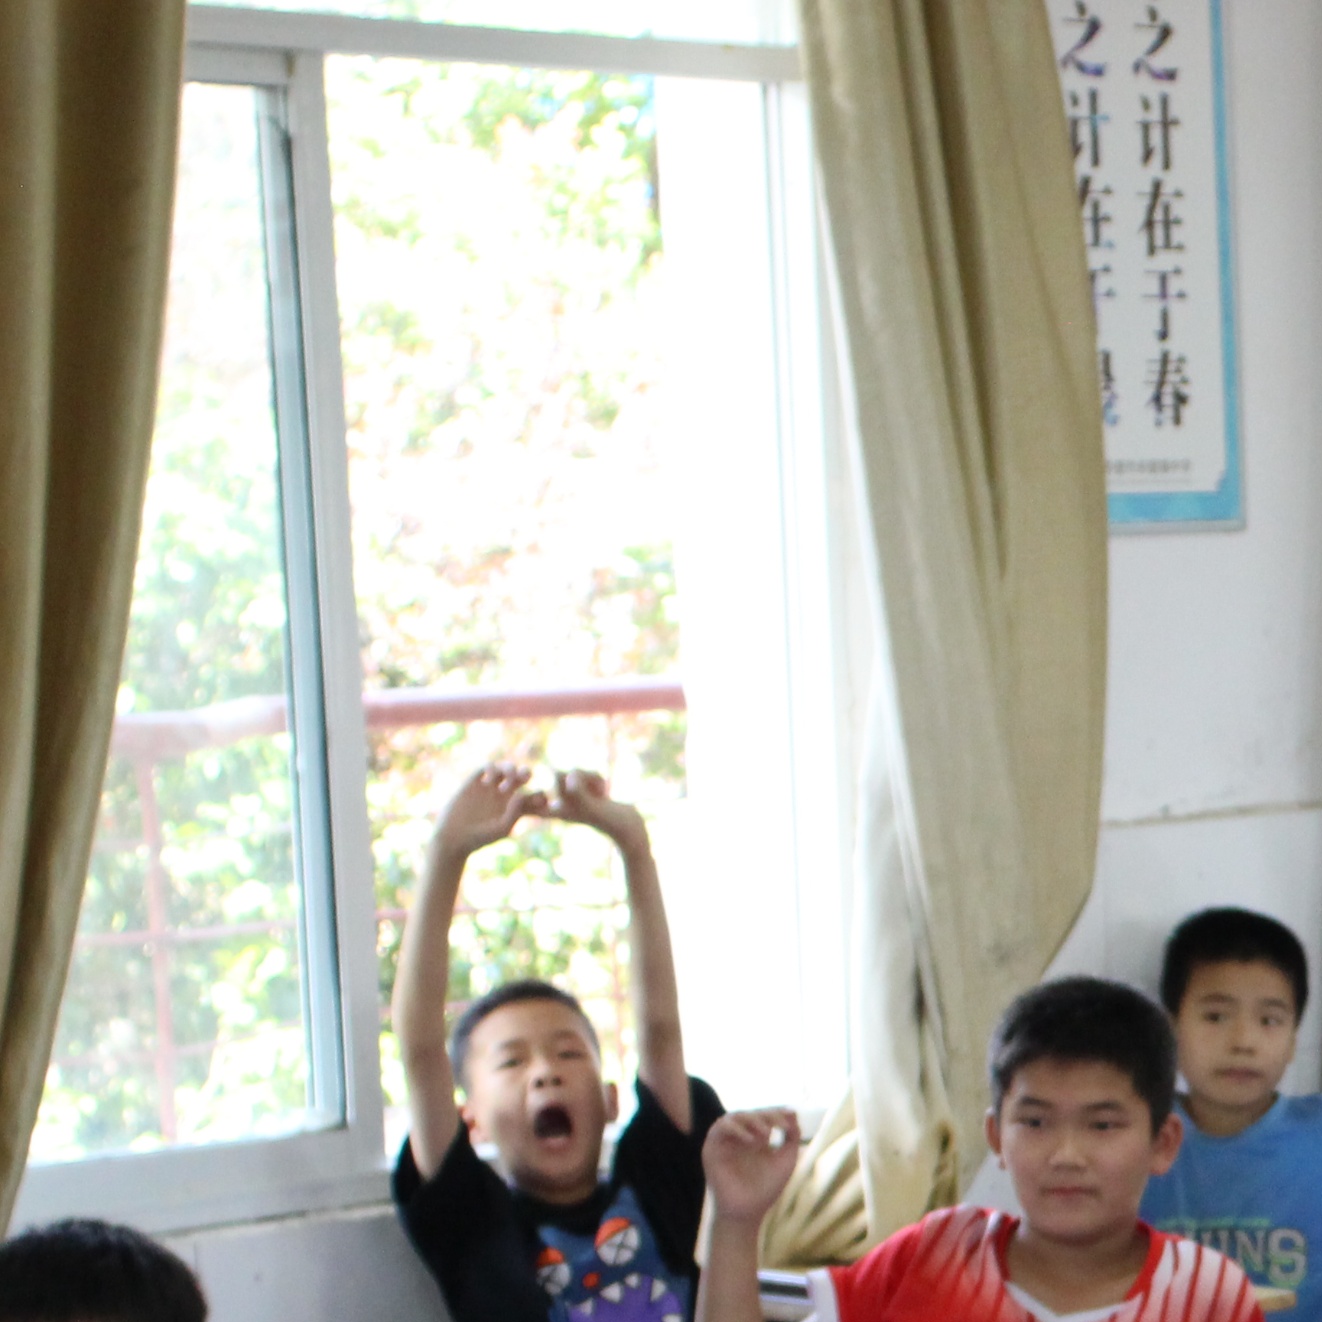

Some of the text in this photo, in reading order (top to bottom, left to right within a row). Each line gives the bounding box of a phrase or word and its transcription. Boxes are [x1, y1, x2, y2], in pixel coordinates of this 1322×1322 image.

[1132, 4, 1191, 428] 之计在于春
